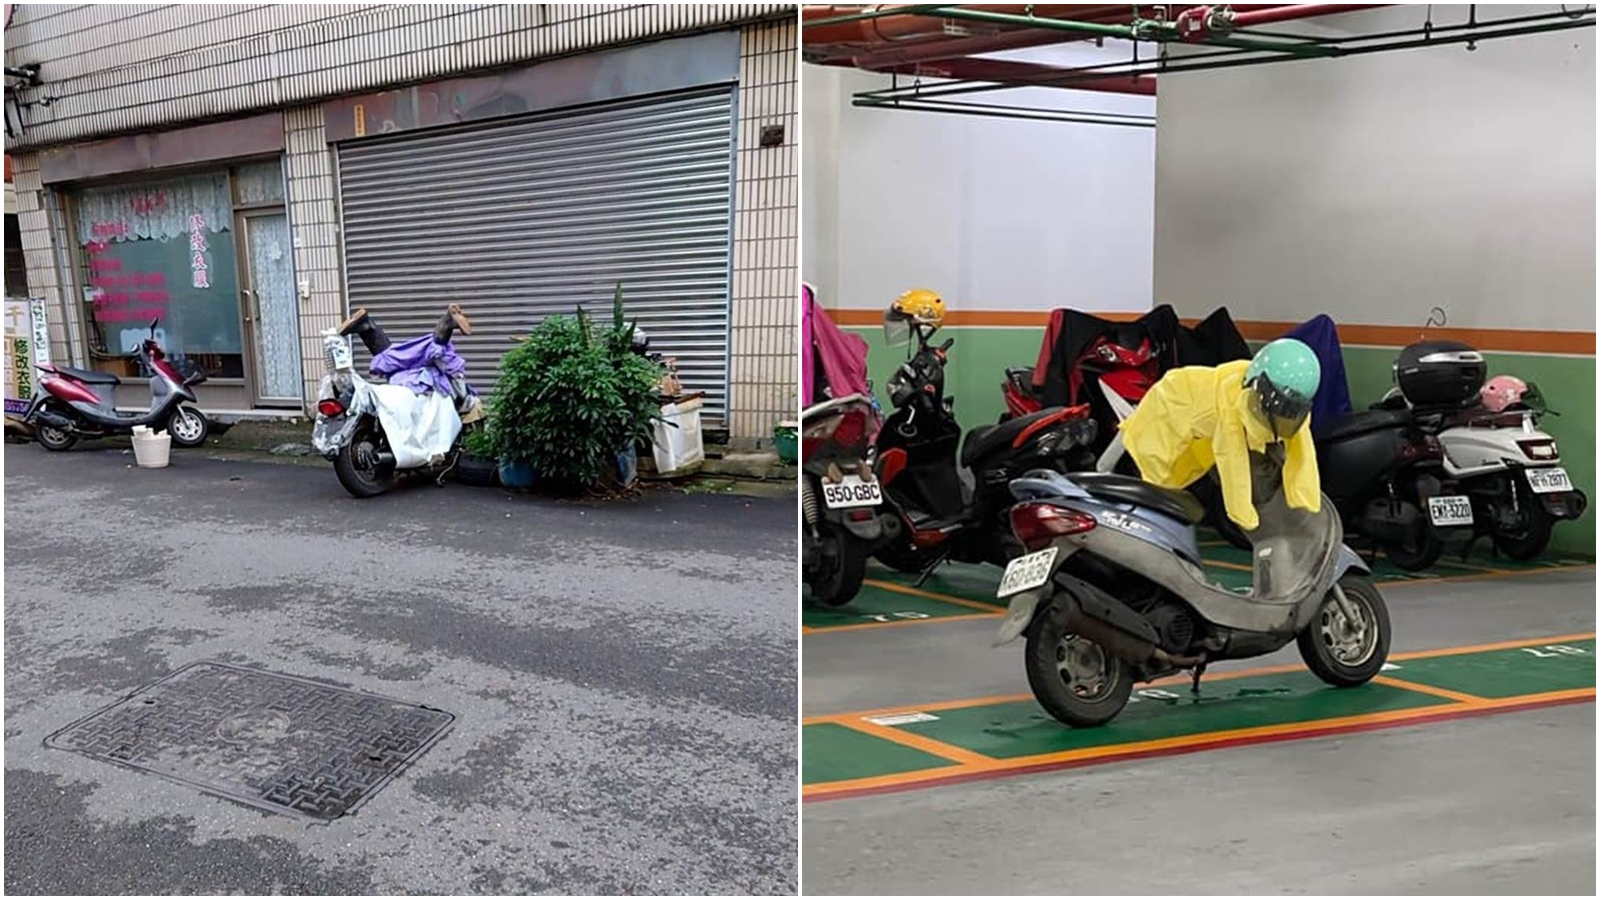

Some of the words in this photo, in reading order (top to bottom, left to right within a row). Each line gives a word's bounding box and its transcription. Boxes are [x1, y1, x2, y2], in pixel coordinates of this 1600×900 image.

[189, 213, 209, 289] 修改衣服
[14, 339, 31, 399] 修改衣服
[826, 484, 880, 503] 950-GBC
